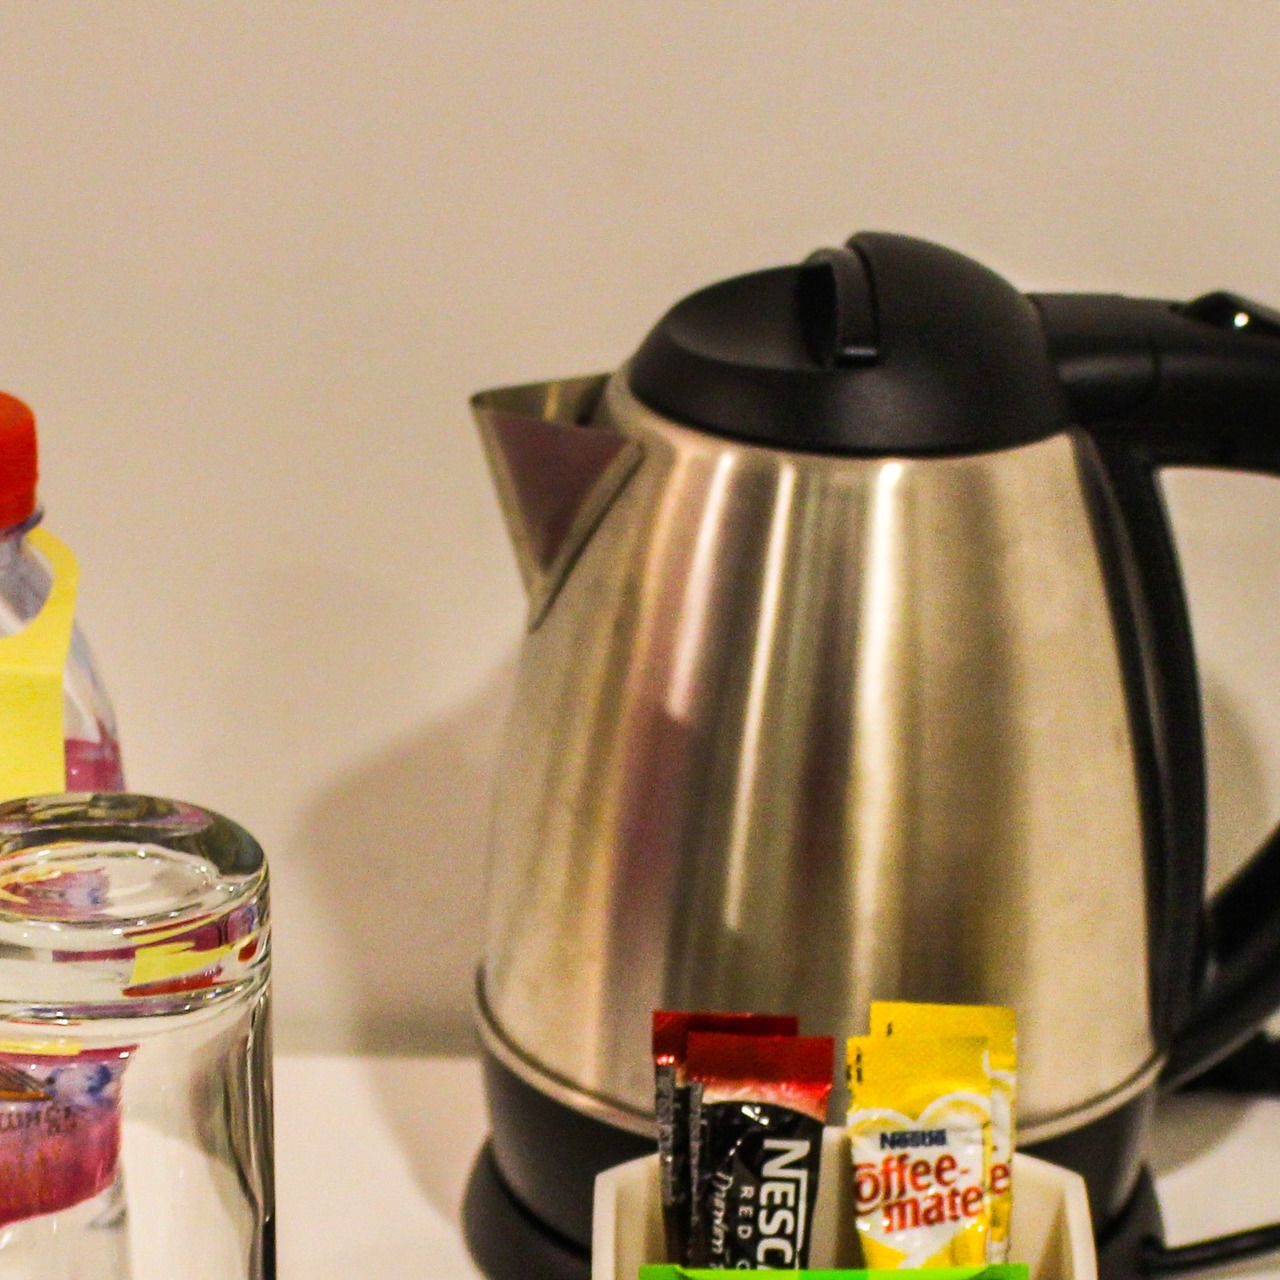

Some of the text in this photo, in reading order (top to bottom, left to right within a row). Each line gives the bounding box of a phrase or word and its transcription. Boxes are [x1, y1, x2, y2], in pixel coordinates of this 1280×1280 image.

[737, 1185, 755, 1240] RED
[756, 1138, 811, 1270] NESC
[882, 1185, 984, 1234] mate
